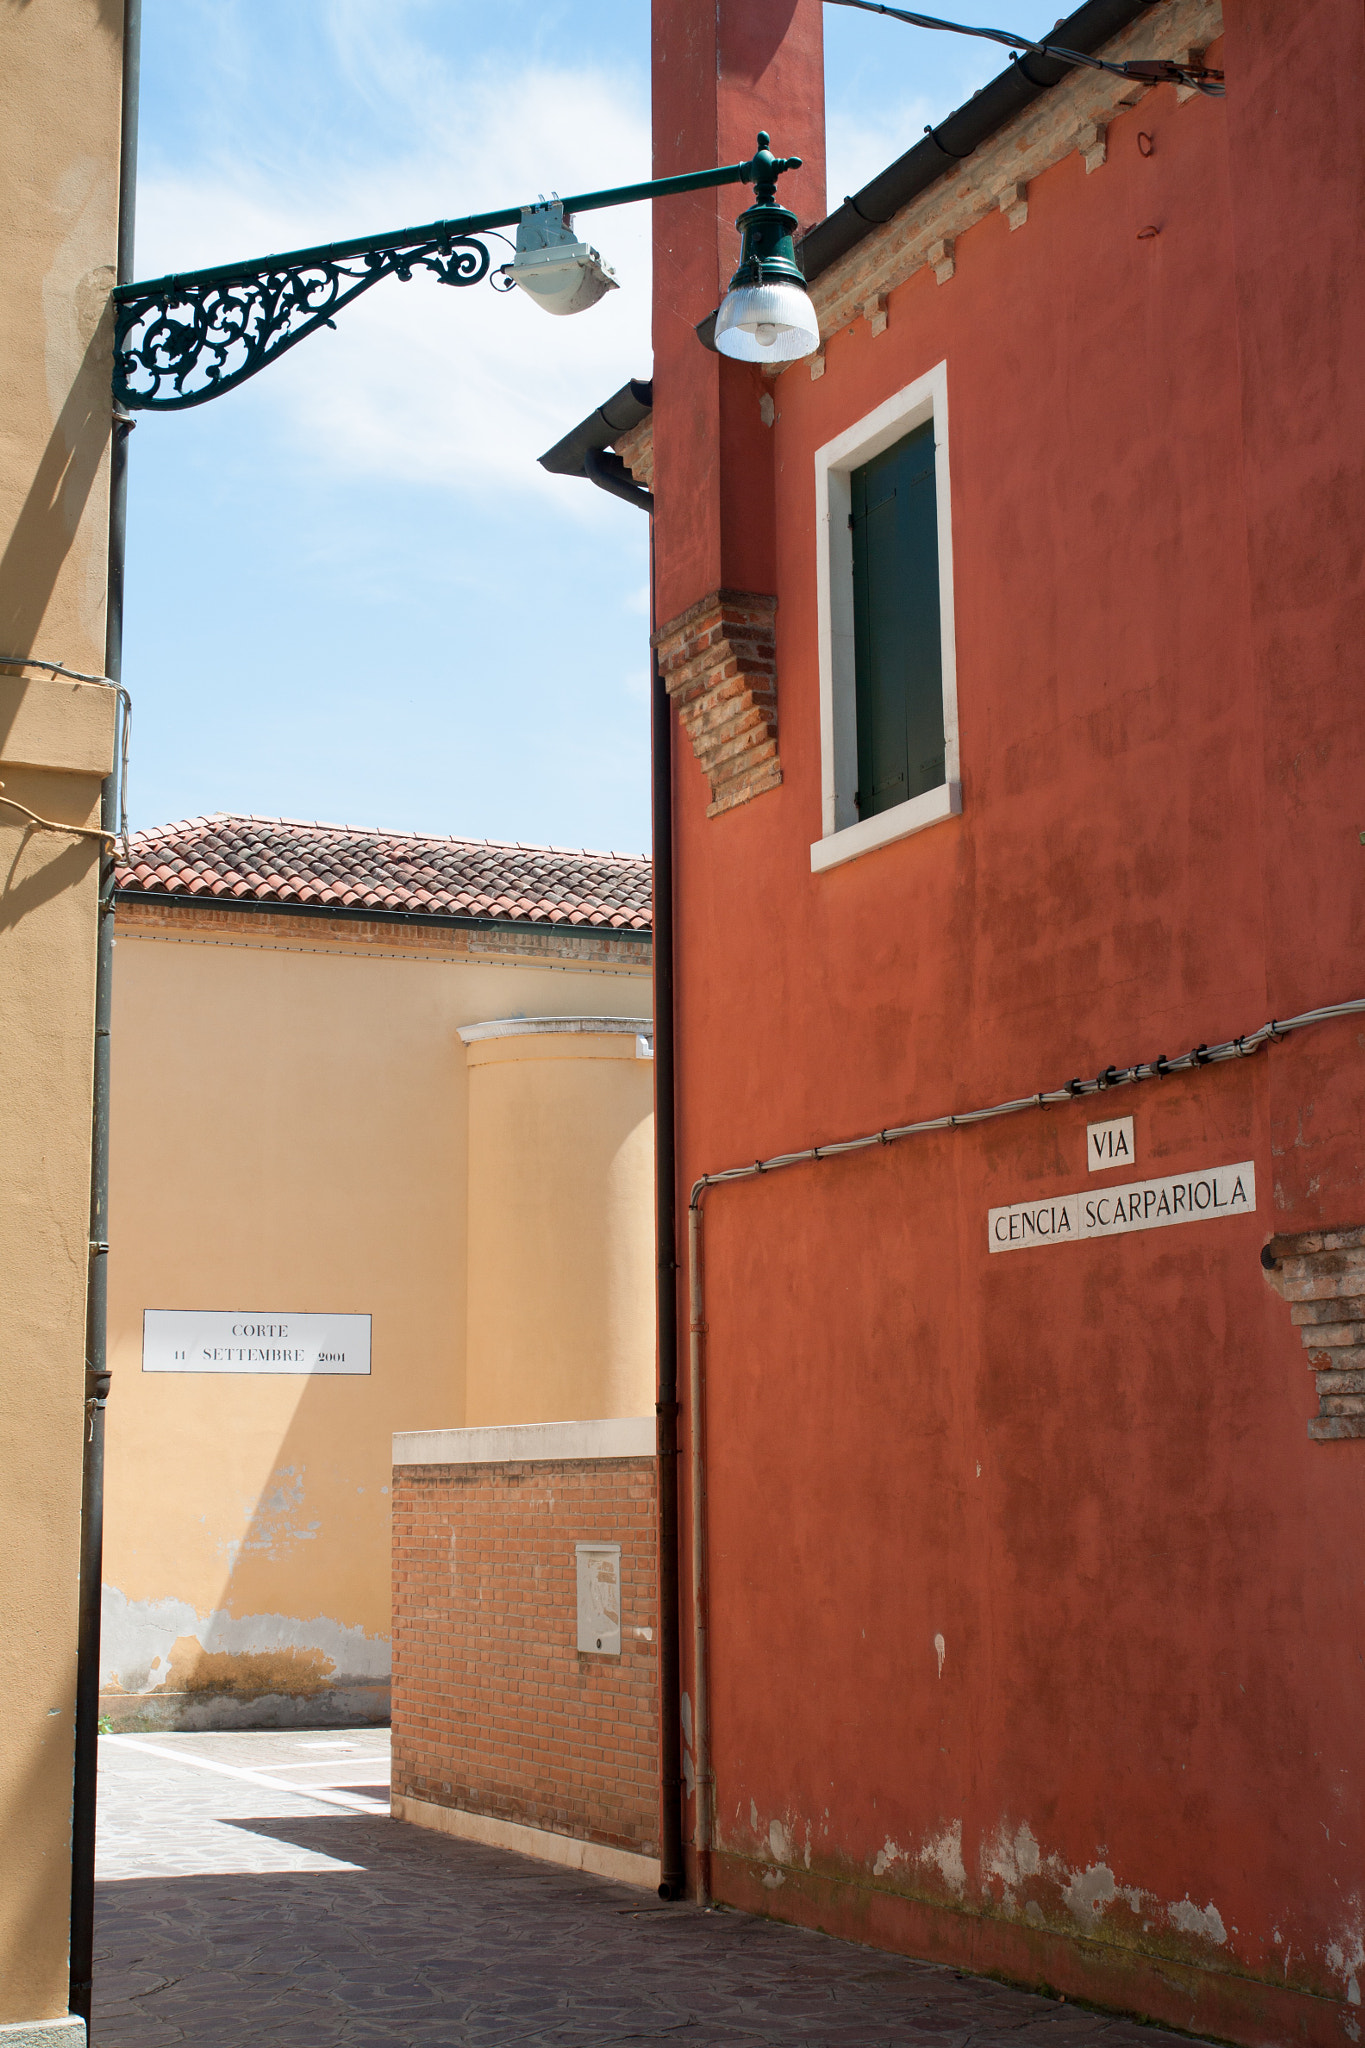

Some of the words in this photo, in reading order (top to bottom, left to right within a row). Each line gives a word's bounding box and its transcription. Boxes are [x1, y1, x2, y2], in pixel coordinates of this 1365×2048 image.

[1093, 1129, 1129, 1158] VIA
[995, 1206, 1071, 1241] CENCIA
[1085, 1175, 1247, 1228] SCARPARIOLA
[232, 1324, 288, 1338] CORTE
[174, 1350, 185, 1360] 11
[202, 1348, 305, 1362] SETTEMBRE
[318, 1352, 345, 1362] 2001
